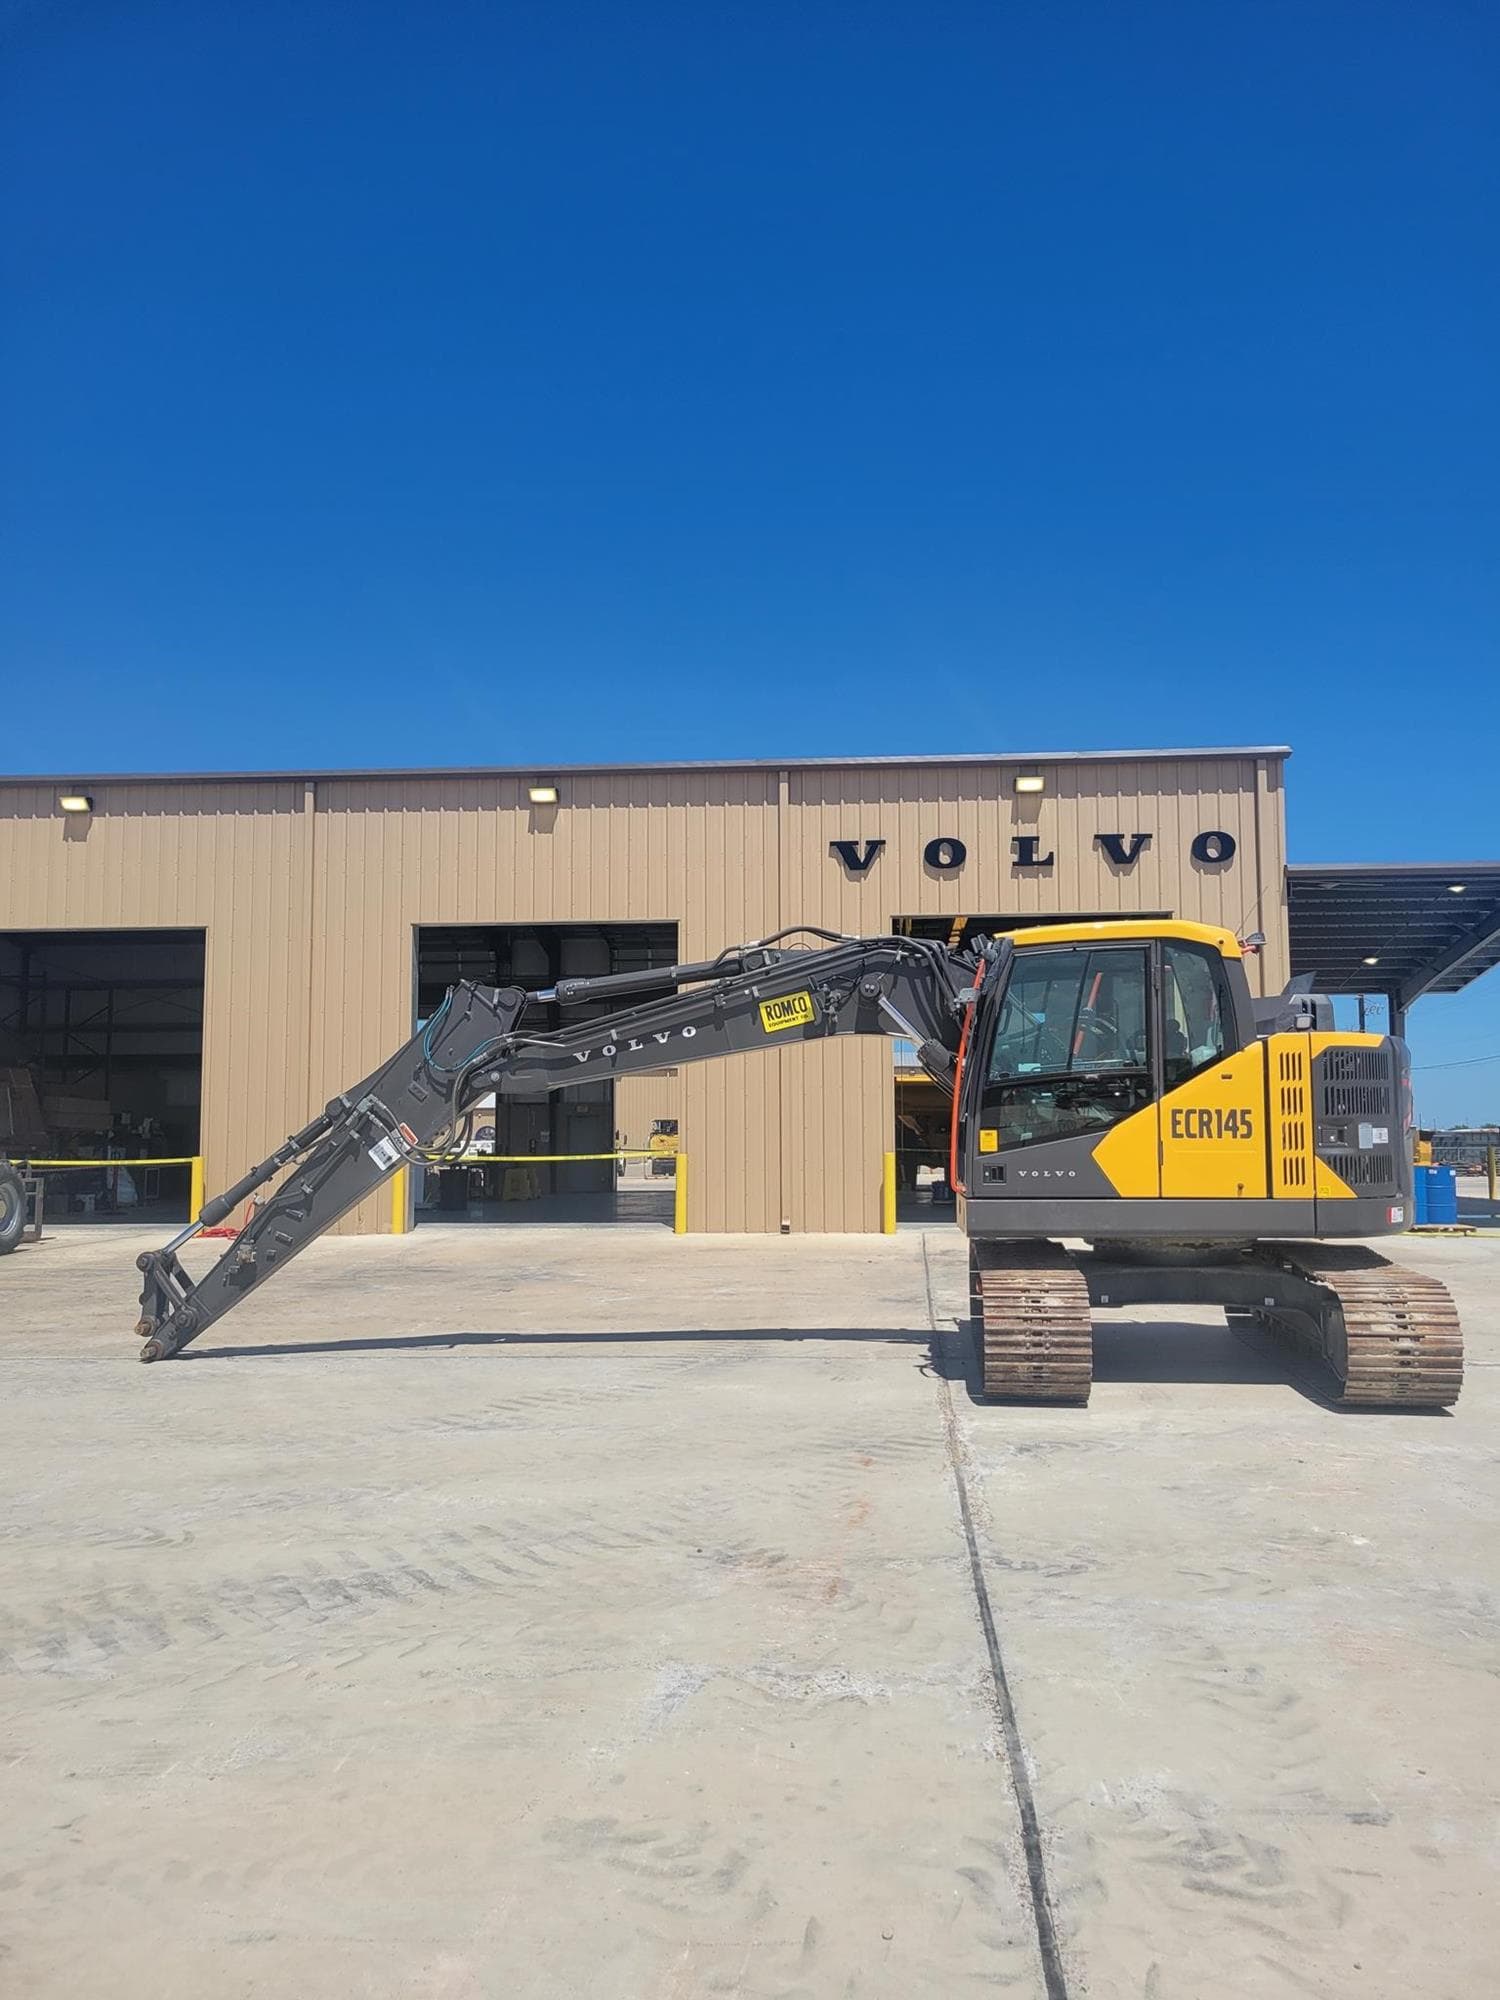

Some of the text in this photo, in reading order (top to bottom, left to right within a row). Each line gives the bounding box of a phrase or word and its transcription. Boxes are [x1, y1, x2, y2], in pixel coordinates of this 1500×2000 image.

[829, 830, 1237, 871] VOLVO
[765, 996, 808, 1021] ROMCO
[573, 1026, 697, 1063] VOLVO
[1171, 1108, 1253, 1139] ECR145
